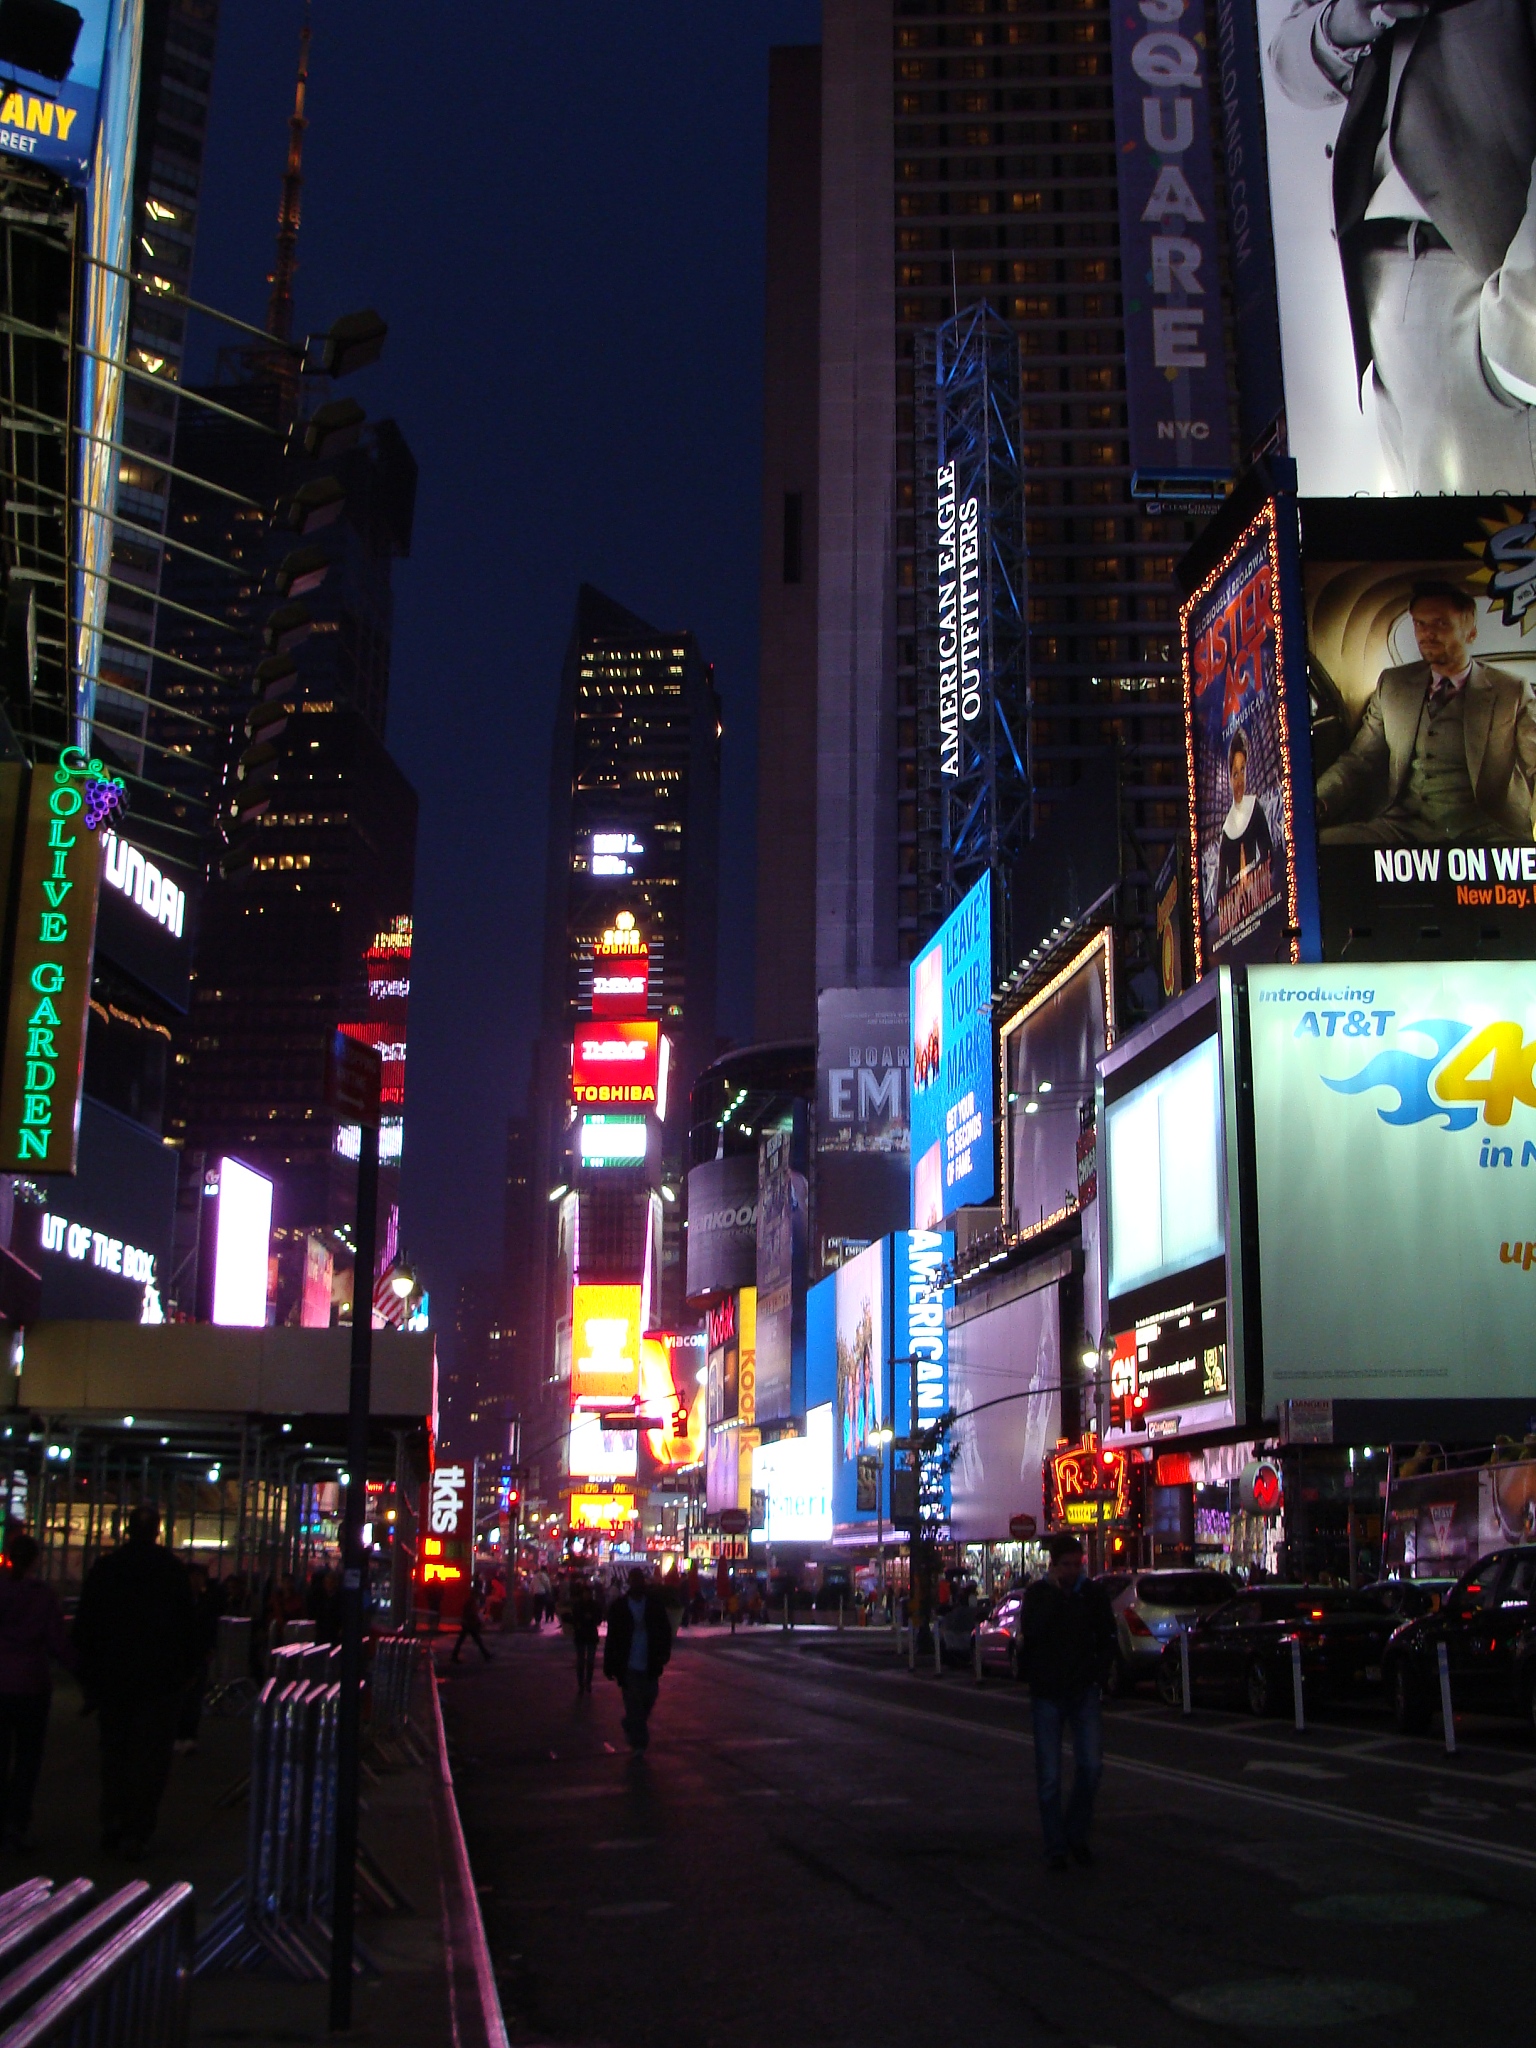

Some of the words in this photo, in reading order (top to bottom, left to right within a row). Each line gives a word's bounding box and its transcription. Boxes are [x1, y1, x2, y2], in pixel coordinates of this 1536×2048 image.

[0, 88, 77, 141] ANY
[1157, 420, 1211, 441] NYC
[936, 458, 957, 567] EAGLE
[958, 496, 983, 722] OUTFITTERS
[1194, 588, 1232, 639] GLORIOUSLY
[1231, 542, 1269, 597] BROADWAY
[1194, 564, 1276, 698] SISTER
[936, 585, 960, 778] AMERICAN
[1222, 625, 1268, 728] ACT
[40, 786, 83, 943] OLIVE
[1373, 848, 1441, 883] NOW
[1447, 847, 1487, 882] ON
[1456, 885, 1493, 906] New
[1494, 884, 1532, 909] Day.
[594, 943, 648, 954] TOSHIBA
[945, 894, 981, 976] LEAVE
[948, 959, 982, 1031] YOUR
[1294, 1011, 1396, 1038] AT&T
[18, 961, 65, 1161] GARDEN
[573, 1085, 655, 1101] TOSHIBA
[828, 1067, 910, 1122] EM
[954, 1112, 983, 1155] SECONDS
[1478, 1138, 1512, 1168] in
[68, 1223, 93, 1260] OF
[93, 1232, 123, 1274] THE
[123, 1245, 156, 1285] BOX
[709, 1295, 739, 1349] Kodak
[907, 1229, 944, 1408] AMERICAN
[1111, 1355, 1136, 1399] CNN
[432, 1465, 466, 1534] tkts
